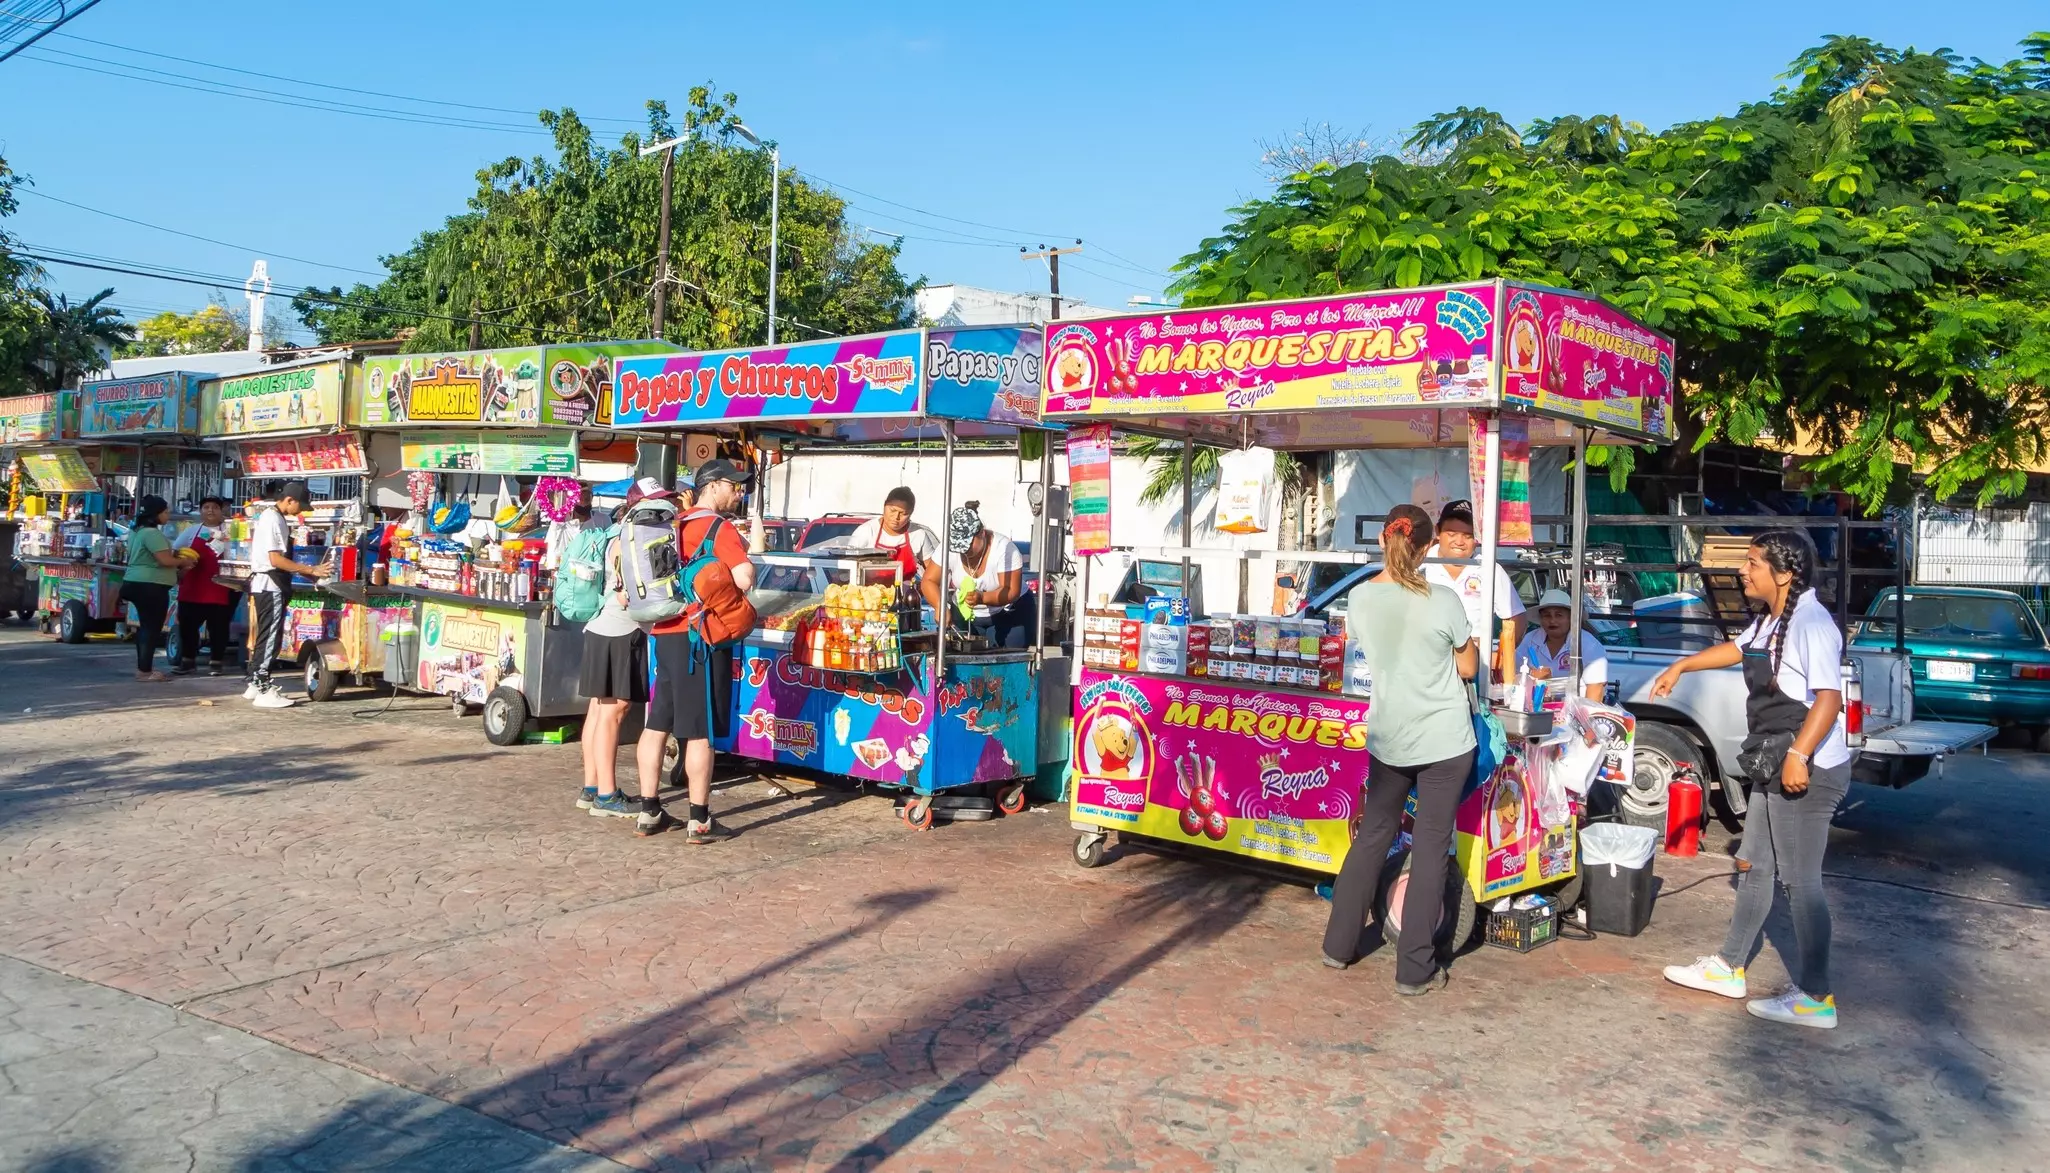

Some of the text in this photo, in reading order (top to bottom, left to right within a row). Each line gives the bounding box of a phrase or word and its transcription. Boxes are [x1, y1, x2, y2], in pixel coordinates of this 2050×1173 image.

[1140, 322, 1156, 338] No
[1159, 321, 1198, 338] Somos
[1200, 318, 1218, 335] los
[1220, 314, 1264, 333] Unicos,
[1271, 310, 1302, 330] Pero
[1321, 306, 1341, 324] los
[1343, 297, 1425, 323] Mejores!!!
[1436, 302, 1459, 316] CON
[1457, 304, 1487, 339] QUESO
[1437, 312, 1453, 325] DE
[1447, 291, 1492, 325] RELLENAS
[1135, 325, 1428, 376] MARQUESITAS
[1559, 317, 1660, 366] MARQUESITAS
[850, 355, 915, 382] Sammy
[928, 341, 999, 386] Papas
[1002, 355, 1018, 387] y
[1584, 367, 1607, 391] Reyna
[96, 380, 165, 402] CHURROS Y PAPAS
[221, 369, 316, 400] MARQUESITAS
[619, 369, 693, 415] Papas
[697, 366, 716, 408] y
[719, 355, 838, 404] Churros
[1225, 380, 1275, 410] Reyna
[0, 396, 53, 416] ARQUESITAS
[410, 383, 479, 418] MARQUESITAS
[1003, 390, 1039, 412] Sam
[1063, 396, 1091, 411] Reyna
[1148, 601, 1169, 610] OREO
[1149, 632, 1179, 642] PHILADELPHIA
[748, 657, 771, 687] y
[1147, 656, 1178, 666] PHILADELPHIA
[1106, 679, 1124, 693] PARA
[1353, 677, 1372, 687] PHILAD
[1165, 685, 1184, 699] No
[1188, 689, 1228, 705] Somos
[1232, 694, 1249, 707] los
[1250, 696, 1300, 714] Unicos,
[1308, 702, 1341, 718] Pero
[751, 709, 817, 751] Sammy
[1163, 700, 1369, 752] MARQUES
[1103, 785, 1144, 810] Reyna
[1260, 766, 1329, 800] Reyna
